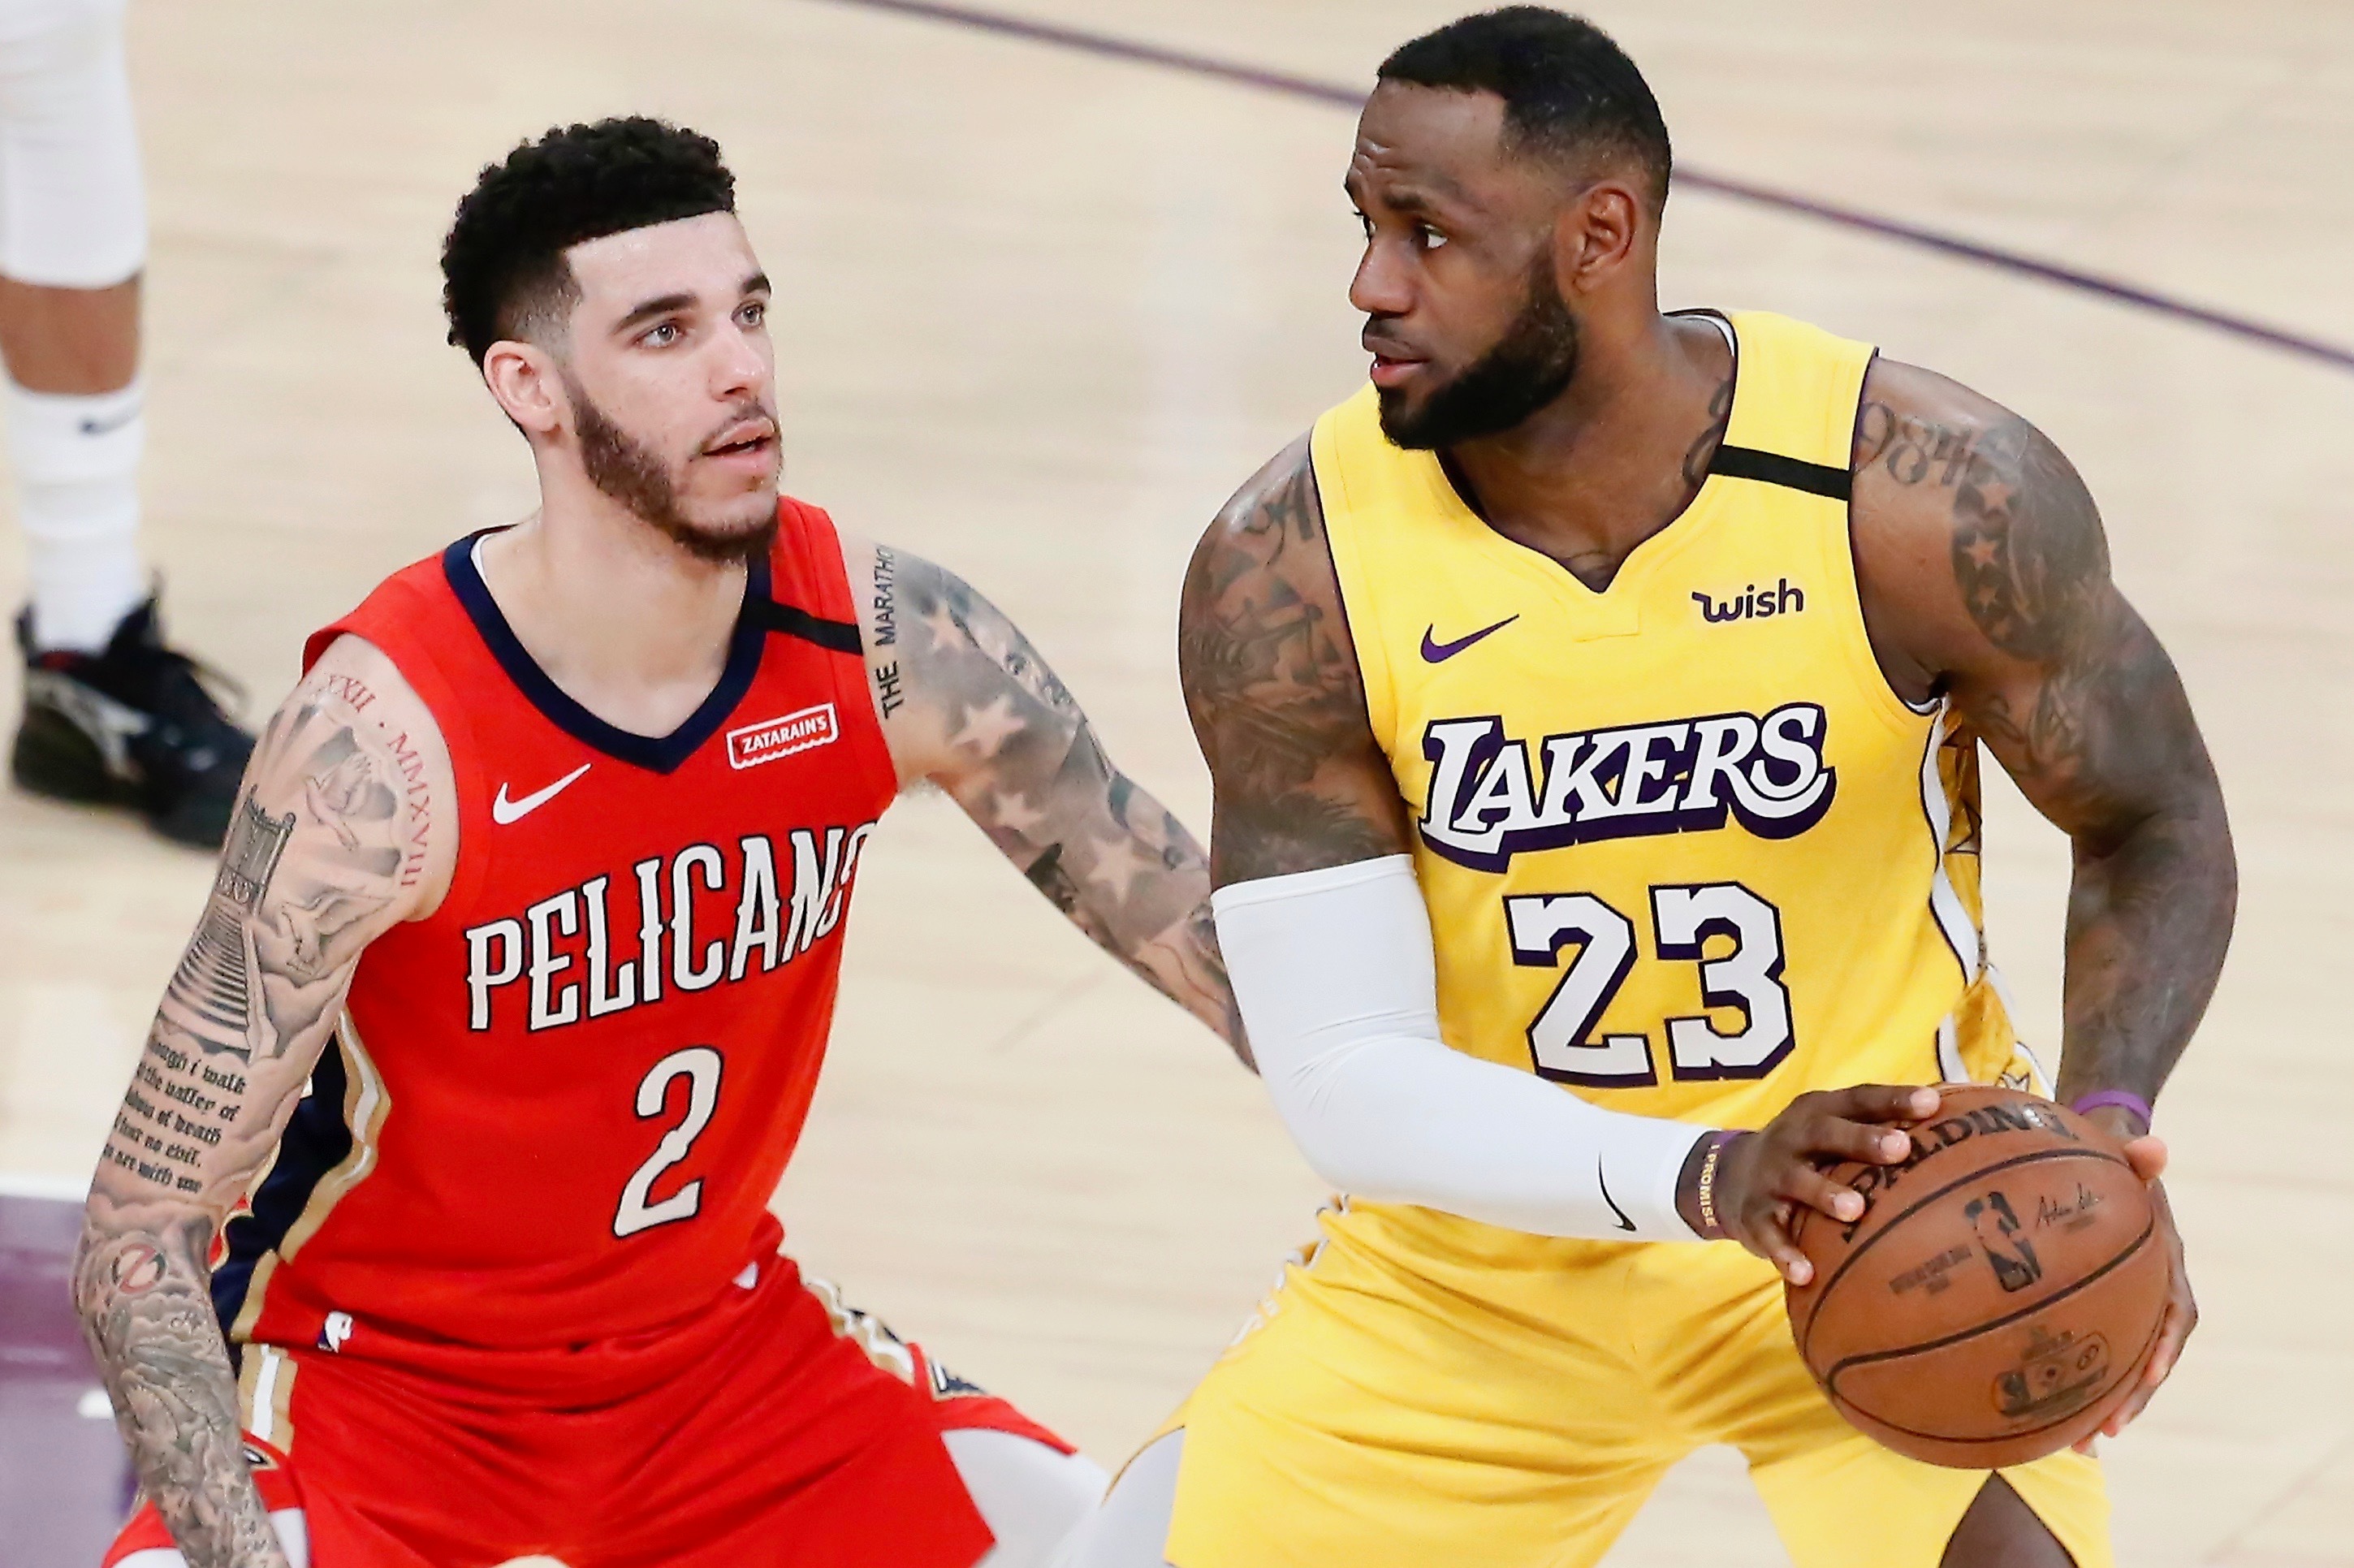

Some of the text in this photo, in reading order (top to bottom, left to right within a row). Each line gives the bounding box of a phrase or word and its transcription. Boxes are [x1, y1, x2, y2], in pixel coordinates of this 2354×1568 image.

[1691, 577, 1804, 623] wish
[875, 660, 905, 719] THE
[387, 732, 430, 888] MMXVIII
[1418, 701, 1838, 875] LAKERS
[1502, 881, 1796, 1088] 23
[613, 1046, 724, 1238] 2
[1699, 1153, 1718, 1228] PROMISE
